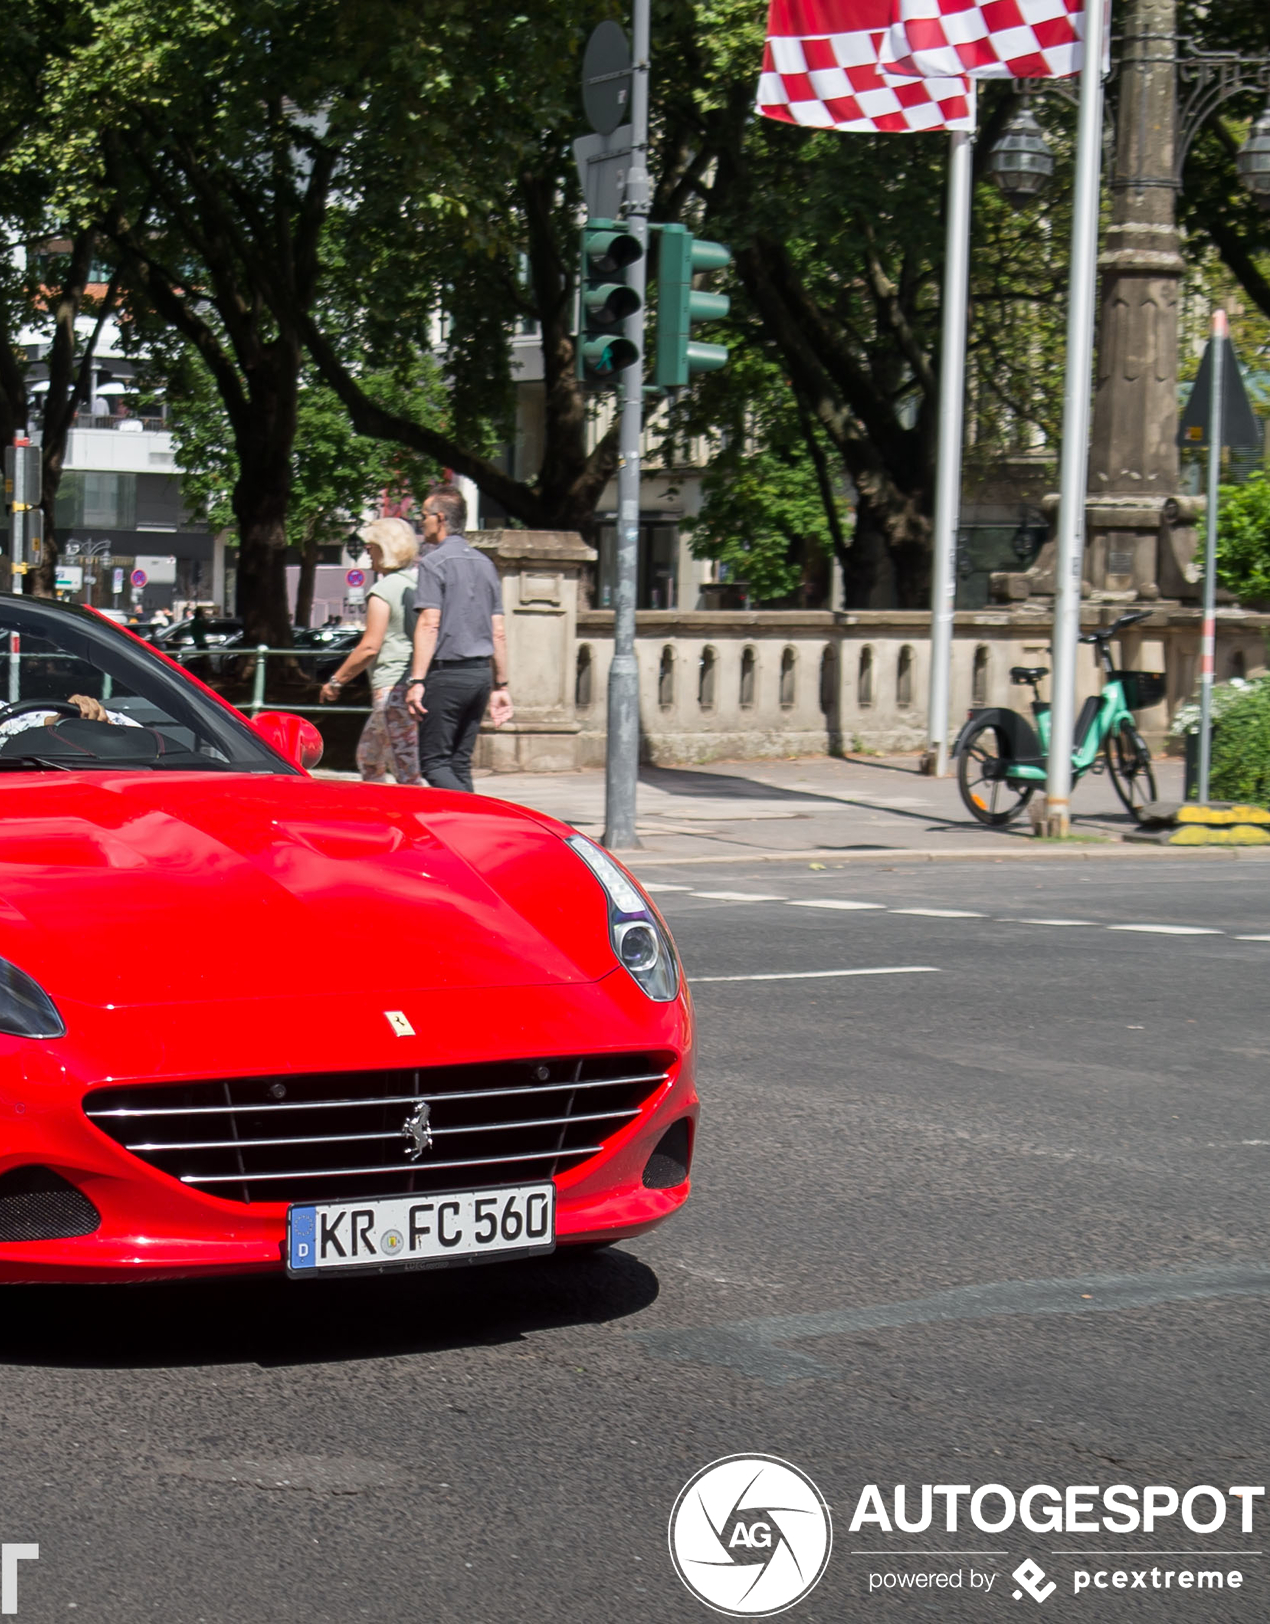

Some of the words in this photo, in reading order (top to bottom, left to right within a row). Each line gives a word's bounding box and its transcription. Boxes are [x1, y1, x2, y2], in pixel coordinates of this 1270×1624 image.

[320, 1209, 377, 1258] KR
[409, 1202, 462, 1251] FC
[475, 1193, 548, 1244] 560
[298, 1243, 309, 1257] D
